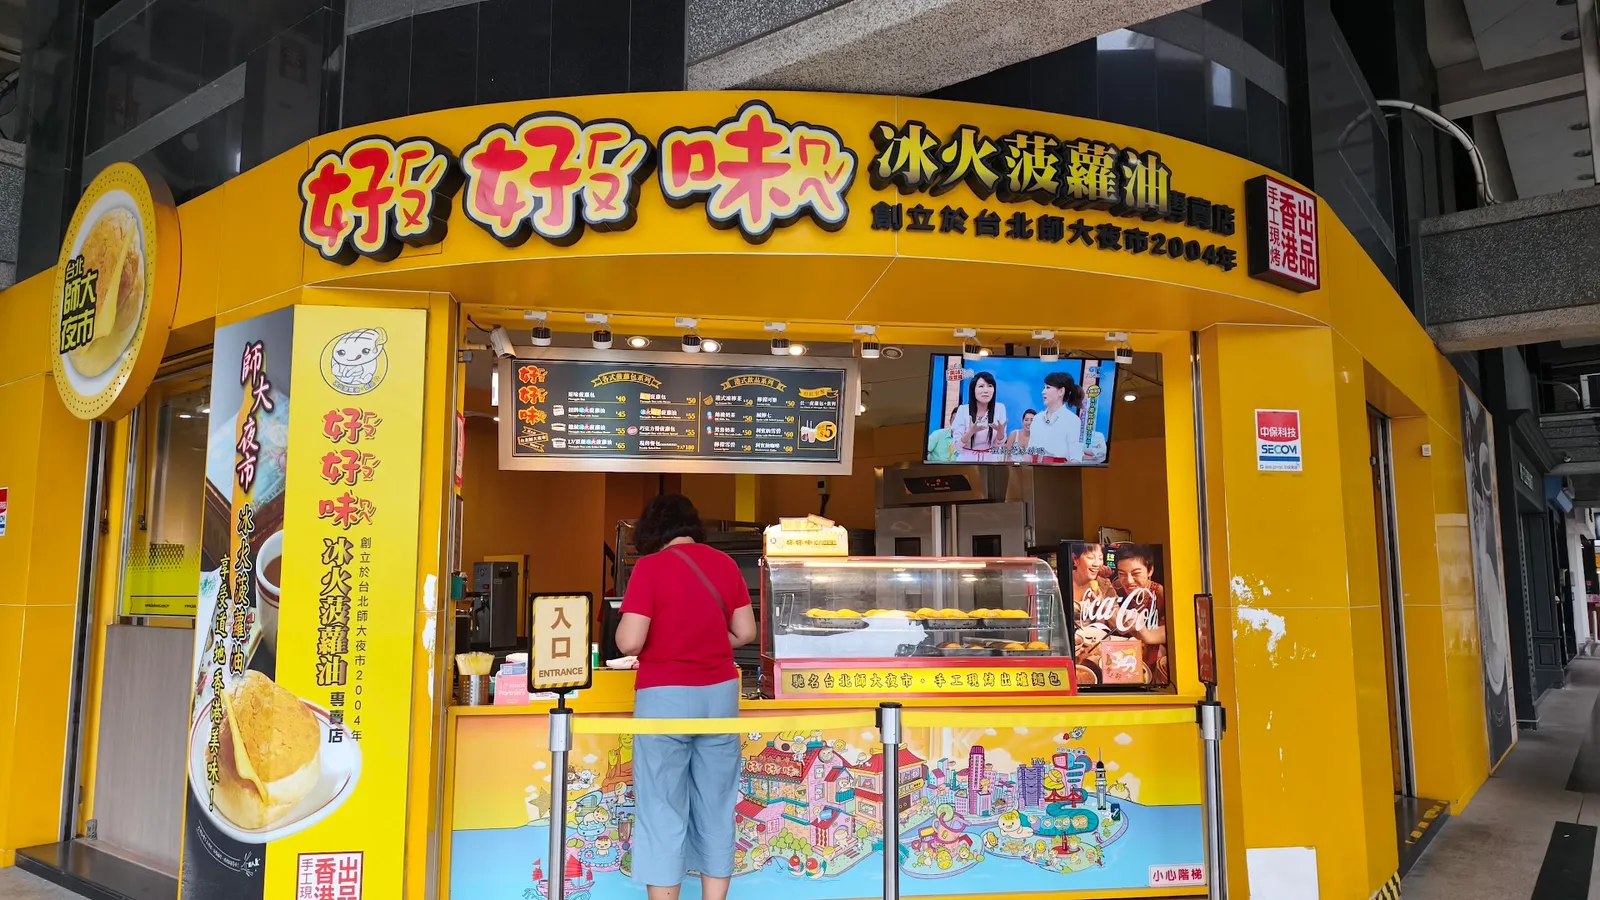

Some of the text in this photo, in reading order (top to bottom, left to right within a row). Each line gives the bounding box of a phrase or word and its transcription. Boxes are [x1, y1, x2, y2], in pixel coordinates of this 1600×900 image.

[872, 120, 1172, 220] 冰火菠蘿油
[870, 201, 1237, 272] 創立於台北師大夜市2004年
[1267, 185, 1281, 268] 手工現烤
[1279, 190, 1299, 274] 香港
[1297, 199, 1316, 280] 出品
[62, 271, 98, 308] 師大
[65, 257, 85, 282] 台北
[60, 310, 95, 353] 夜市
[237, 341, 274, 494] 師大夜市
[1260, 426, 1297, 438] 中保科技
[1261, 444, 1297, 454] SECOM
[317, 407, 383, 531] 好好味
[229, 503, 255, 678] 冰火菠蘿油
[315, 536, 354, 687] 冰火菠蘿油
[350, 536, 372, 742] 創立於台北師大夜市2004年
[550, 606, 572, 660] 入口
[538, 666, 584, 679] ENTRANCE
[328, 691, 345, 743] 專賣店
[1152, 868, 1203, 882] 小心階梯
